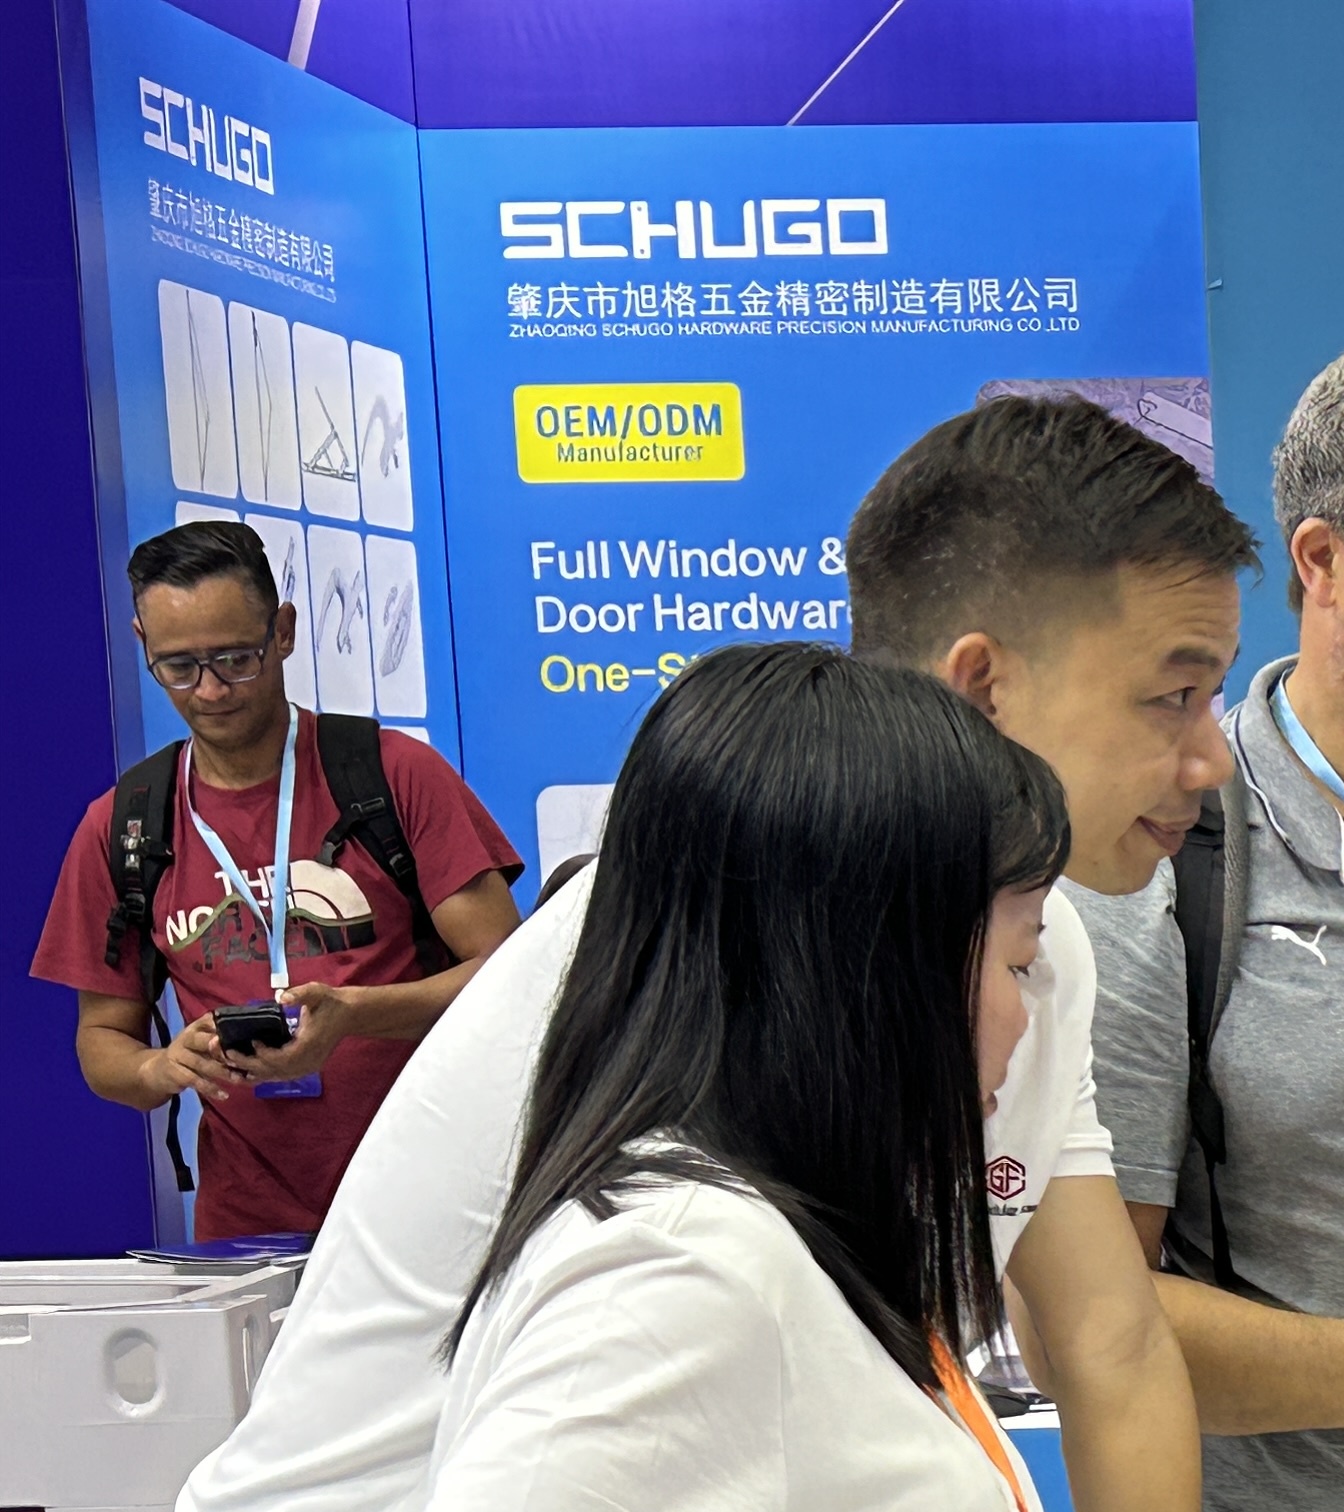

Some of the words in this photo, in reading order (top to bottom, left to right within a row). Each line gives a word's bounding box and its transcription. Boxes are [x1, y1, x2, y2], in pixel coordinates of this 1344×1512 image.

[139, 76, 275, 195] SCHUGO
[500, 198, 889, 259] SCHUGO
[508, 277, 1078, 319] 肇庆市旭格五金精密制造有限公司
[508, 323, 598, 338] ZHAOQING
[603, 322, 673, 337] SCHUGO
[678, 321, 772, 336] HARDWARE
[776, 319, 867, 335] PRECISION
[871, 318, 1013, 334] MANUFACTURING
[536, 403, 723, 440] OEM/ODM
[557, 440, 704, 463] Manufacturer
[530, 540, 611, 580] Full
[618, 538, 808, 578] Window
[818, 536, 848, 576] &
[535, 595, 644, 633] Door
[653, 592, 853, 631] Hardwar
[540, 652, 698, 692] One-S
